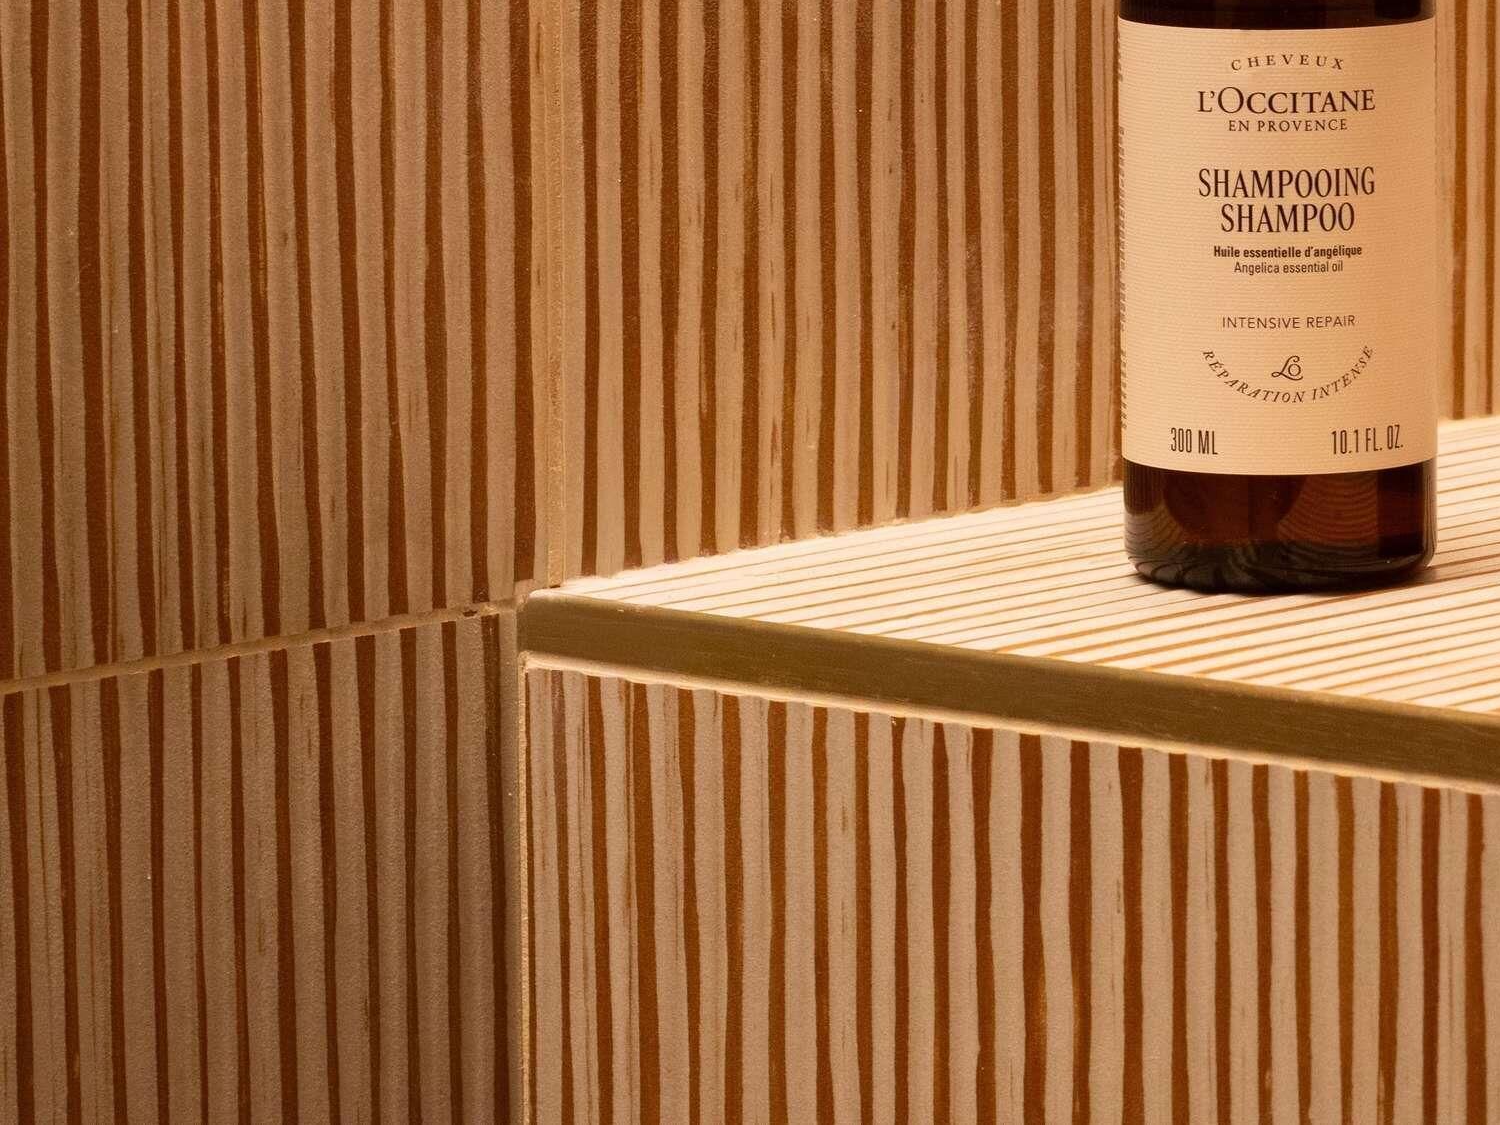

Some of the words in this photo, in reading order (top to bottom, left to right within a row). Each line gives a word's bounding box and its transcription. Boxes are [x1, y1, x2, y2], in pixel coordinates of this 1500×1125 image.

[1231, 54, 1344, 71] CHEVEUX
[1198, 86, 1376, 114] L'OCCITANE
[1228, 120, 1252, 132] EN
[1257, 119, 1348, 132] PROVENCE
[1199, 166, 1375, 198] SHAMPOOING
[1220, 202, 1355, 233] SHAMPOO
[1214, 246, 1240, 257] Huile
[1243, 246, 1301, 258] essentielle
[1304, 245, 1362, 259] d'angélique
[1234, 262, 1279, 275] Angelica
[1283, 261, 1328, 273] essential
[1332, 261, 1343, 272] oil
[1222, 316, 1300, 329] INTENSIVE
[1306, 315, 1355, 328] REPAIR
[1203, 350, 1306, 403] RÉPARATION
[1312, 345, 1374, 400] INTENSE
[1170, 427, 1192, 453] 300
[1198, 429, 1218, 455] ML
[1331, 428, 1360, 454] 10.1
[1365, 427, 1383, 452] FL.
[1387, 424, 1404, 449] OZ.
